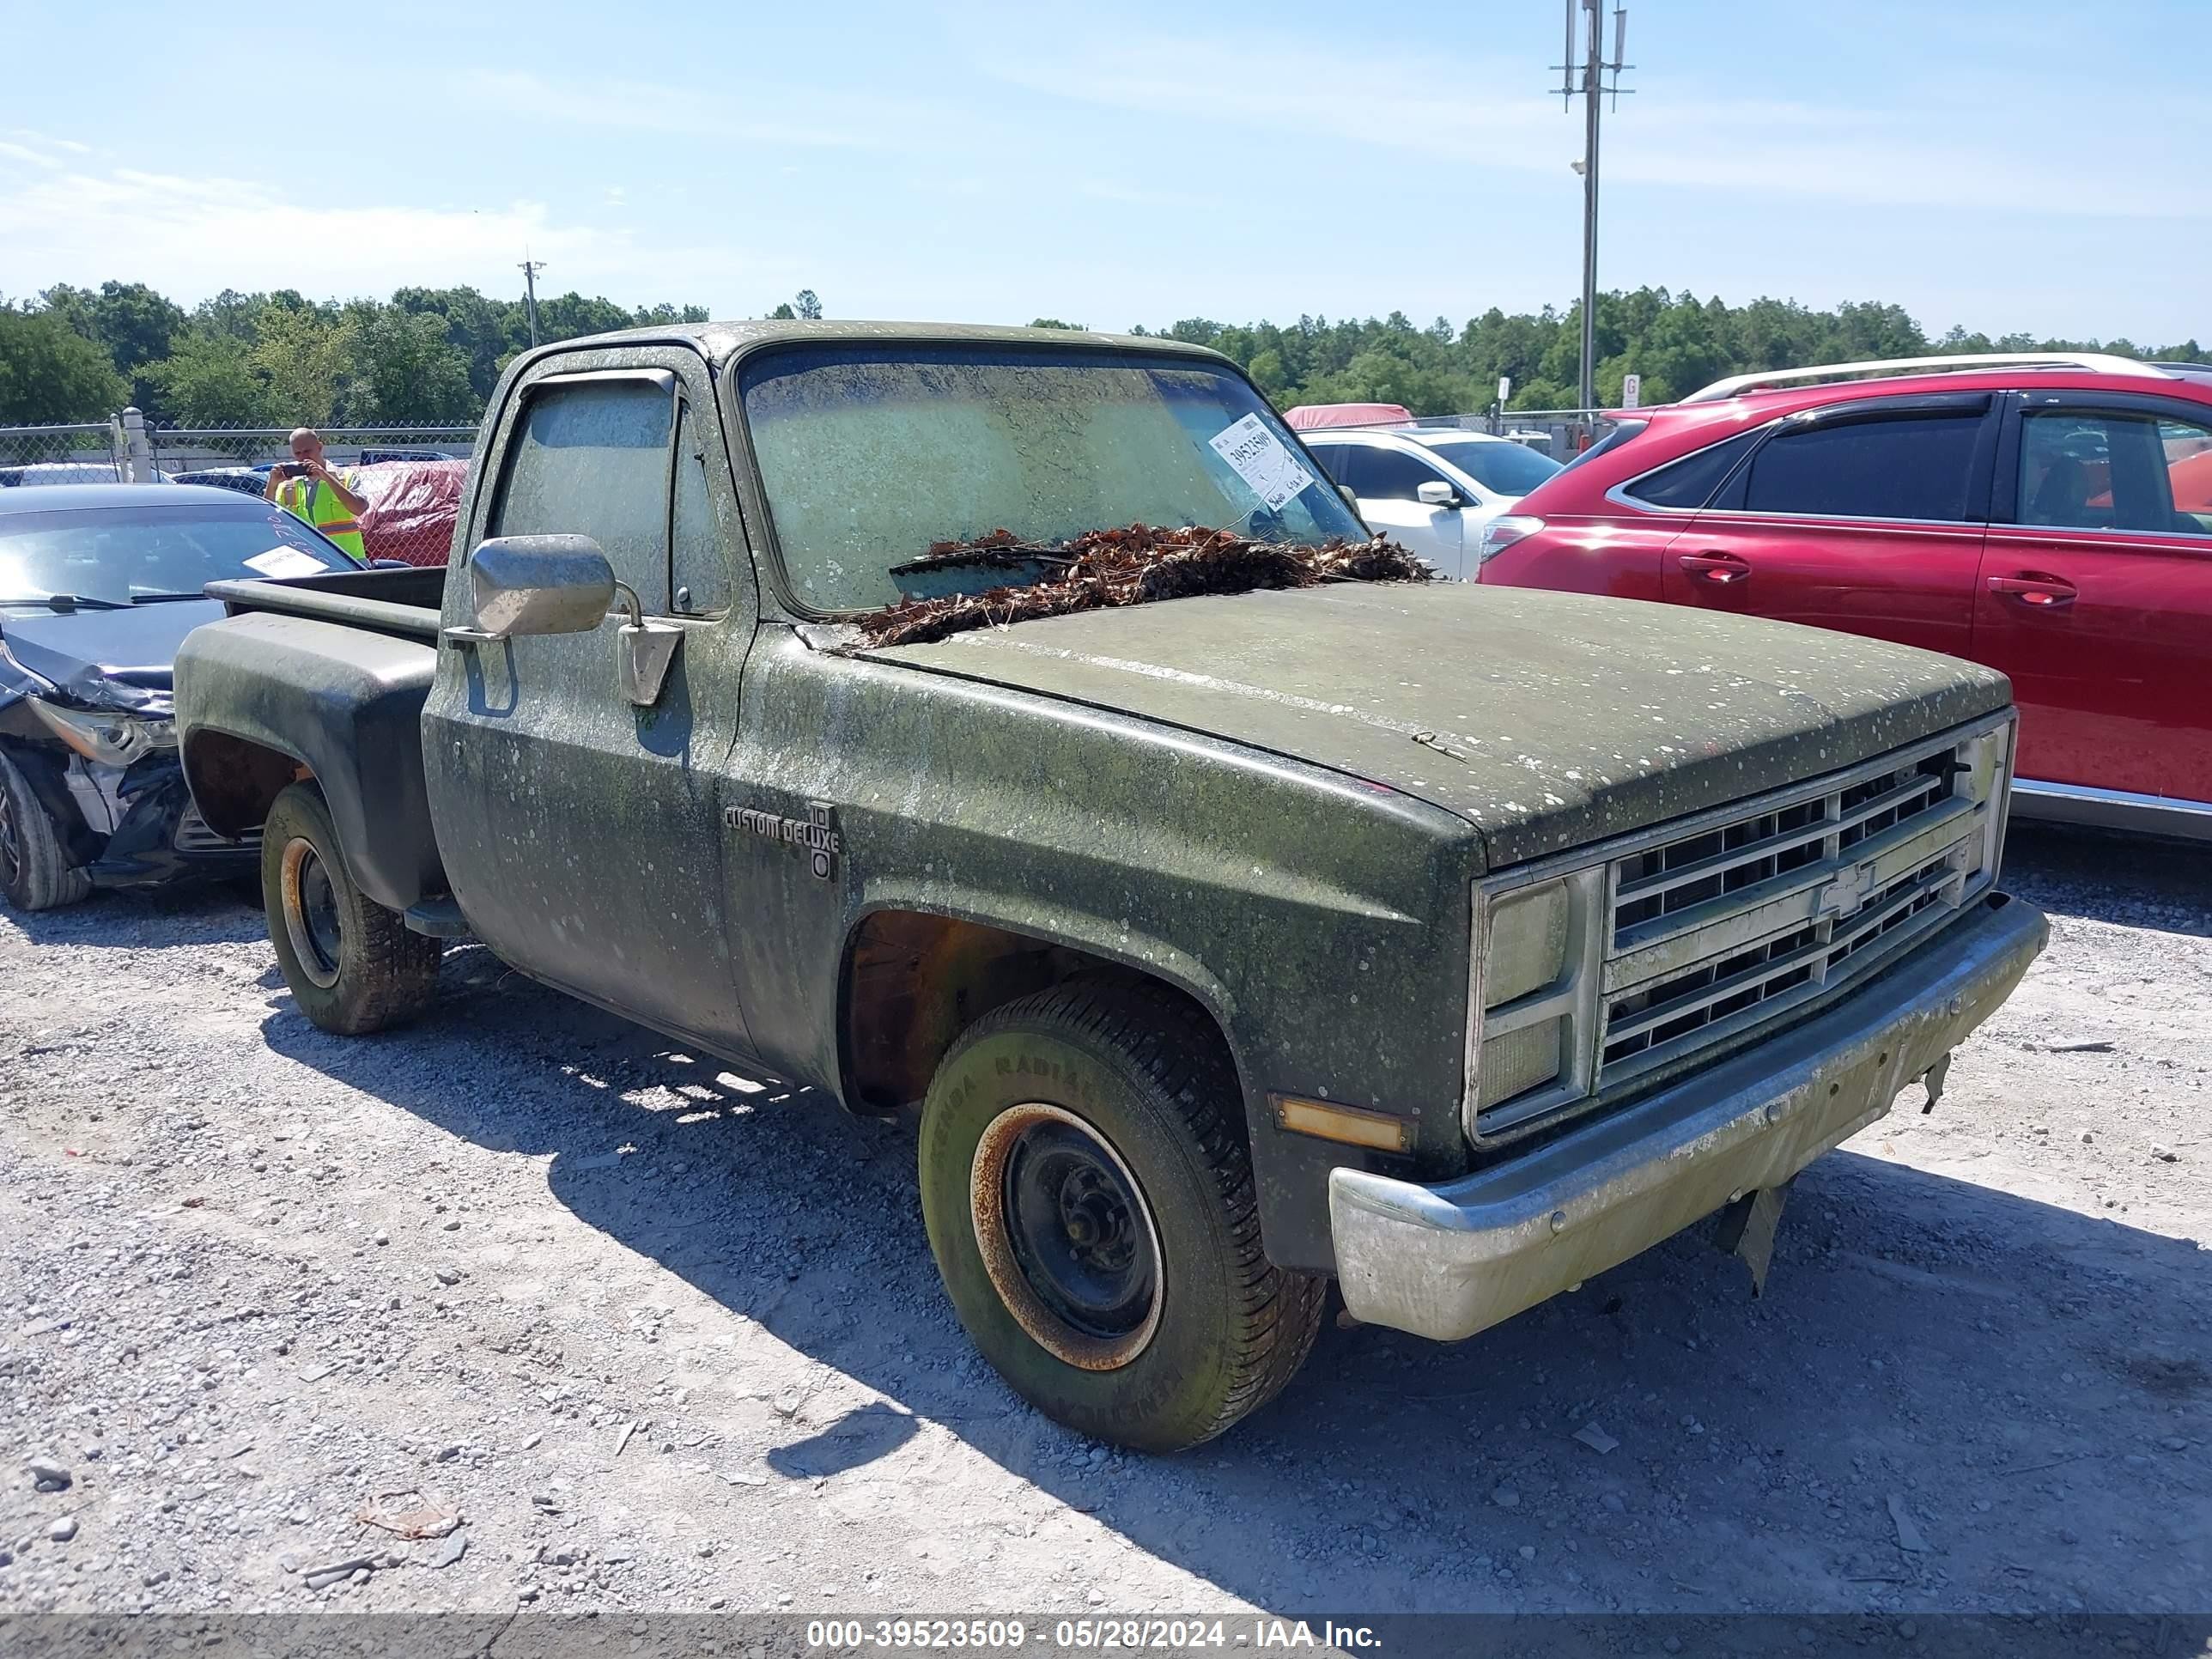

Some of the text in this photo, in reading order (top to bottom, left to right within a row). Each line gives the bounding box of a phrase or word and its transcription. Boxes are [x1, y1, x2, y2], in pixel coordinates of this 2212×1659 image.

[1627, 378, 1636, 394] G
[1231, 431, 1272, 466] 39523509
[725, 805, 840, 853] CUSTOM DELUXE
